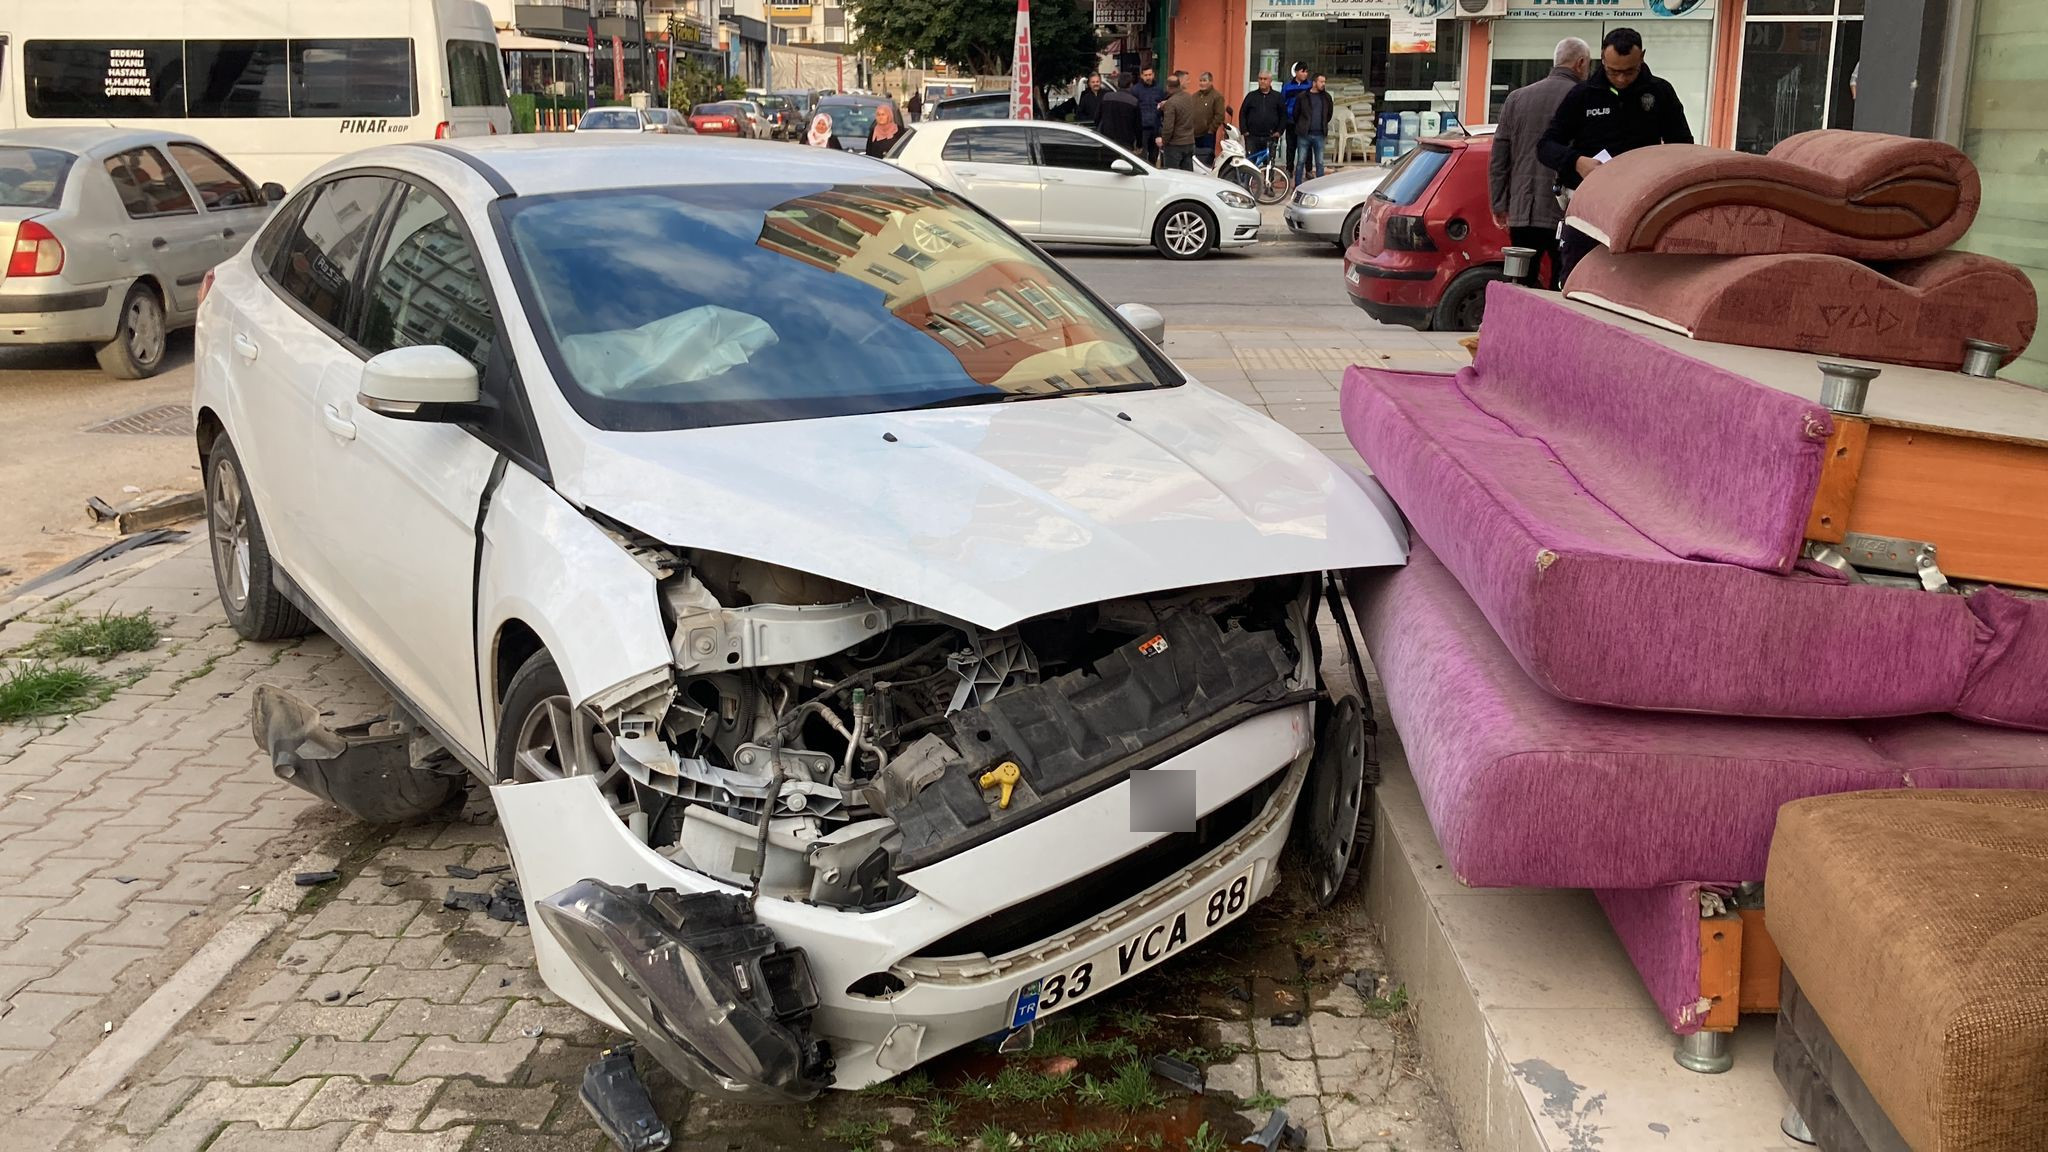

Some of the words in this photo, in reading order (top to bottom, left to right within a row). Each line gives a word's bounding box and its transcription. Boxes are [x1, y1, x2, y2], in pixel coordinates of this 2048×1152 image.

[108, 68, 147, 77] HASTANE
[339, 119, 388, 133] PINAR
[387, 125, 409, 133] KOOP
[1019, 1001, 1036, 1016] TR
[1039, 962, 1093, 1011] 33
[1118, 911, 1187, 976] VCA
[1205, 875, 1248, 928] 88
